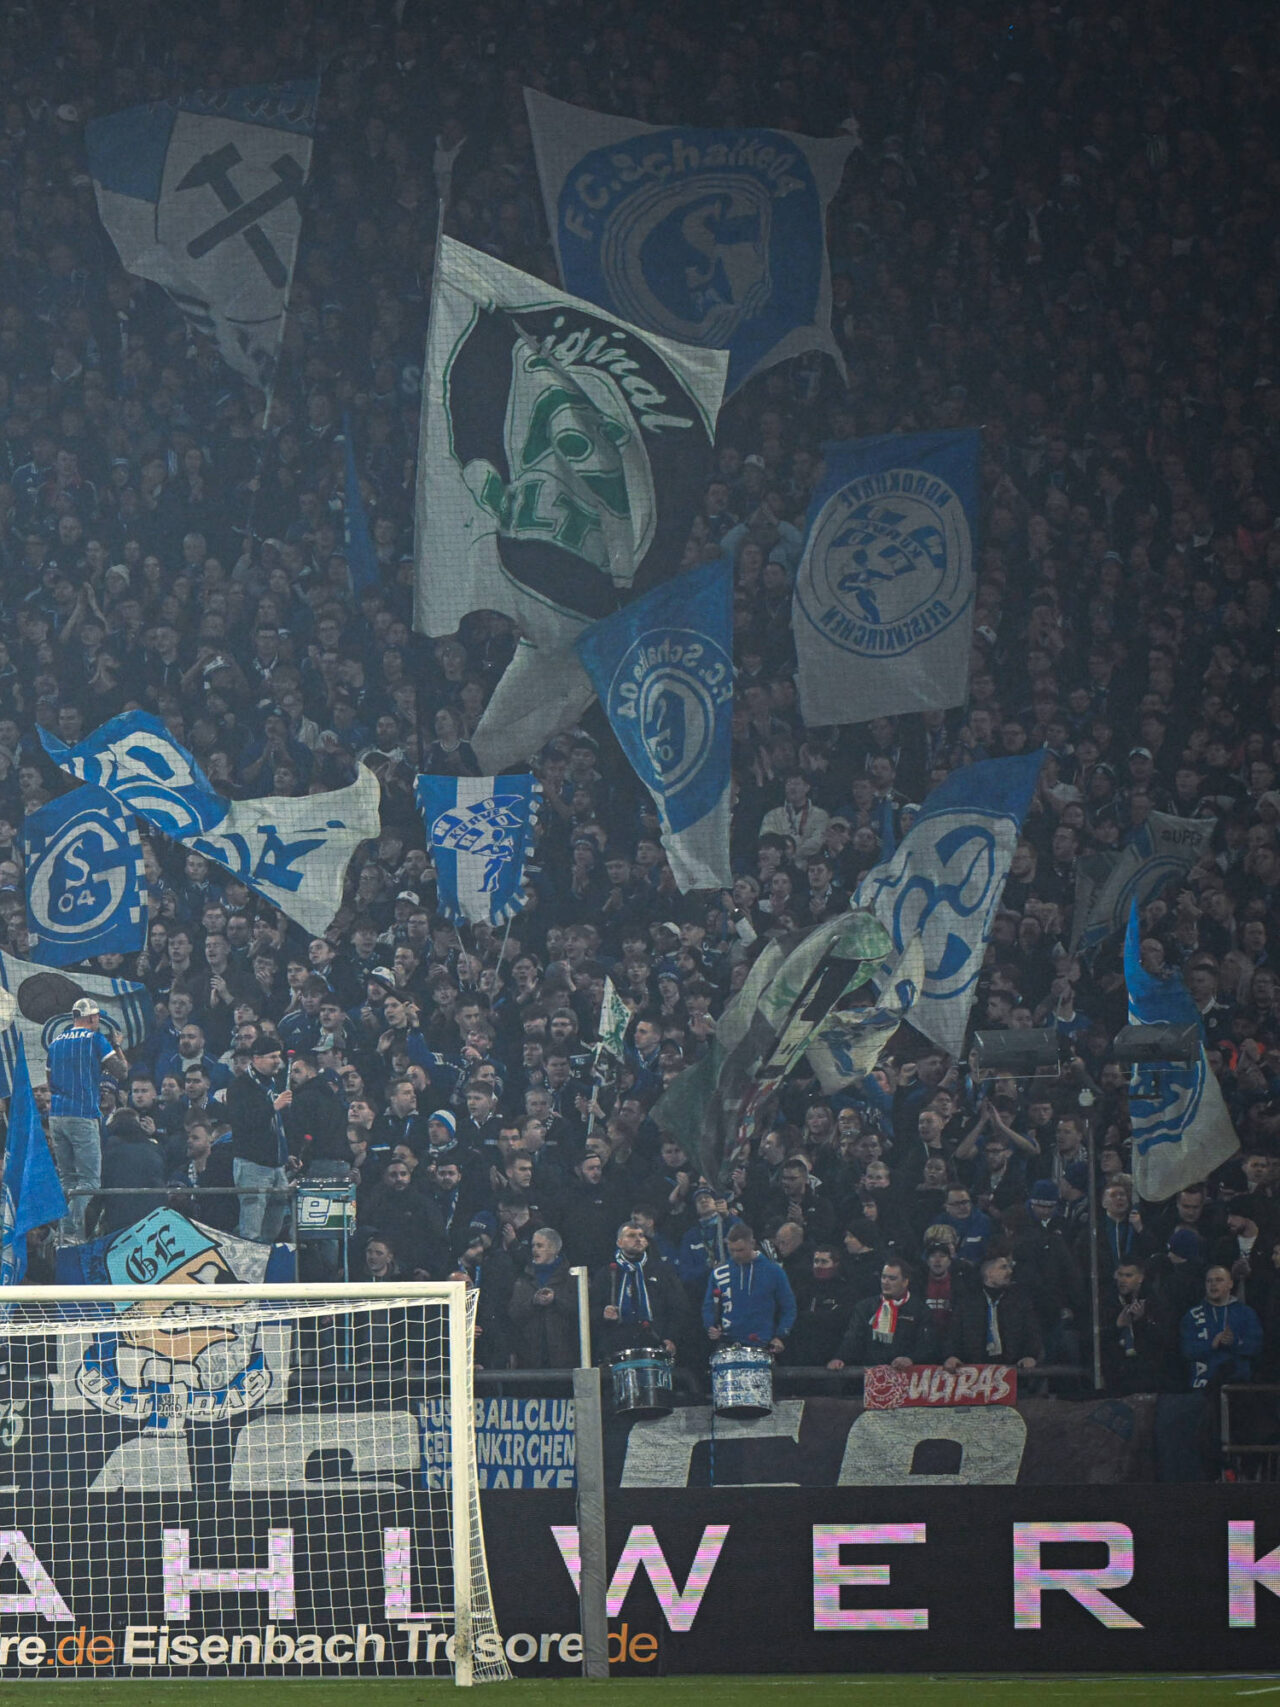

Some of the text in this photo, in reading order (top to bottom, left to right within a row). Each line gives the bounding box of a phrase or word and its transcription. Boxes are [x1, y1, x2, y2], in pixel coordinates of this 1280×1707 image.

[713, 1263, 734, 1336] ULTRA
[1189, 1304, 1209, 1389] ULTAS
[906, 1364, 1012, 1404] ULTRAS
[123, 1622, 385, 1667] Eisenbach
